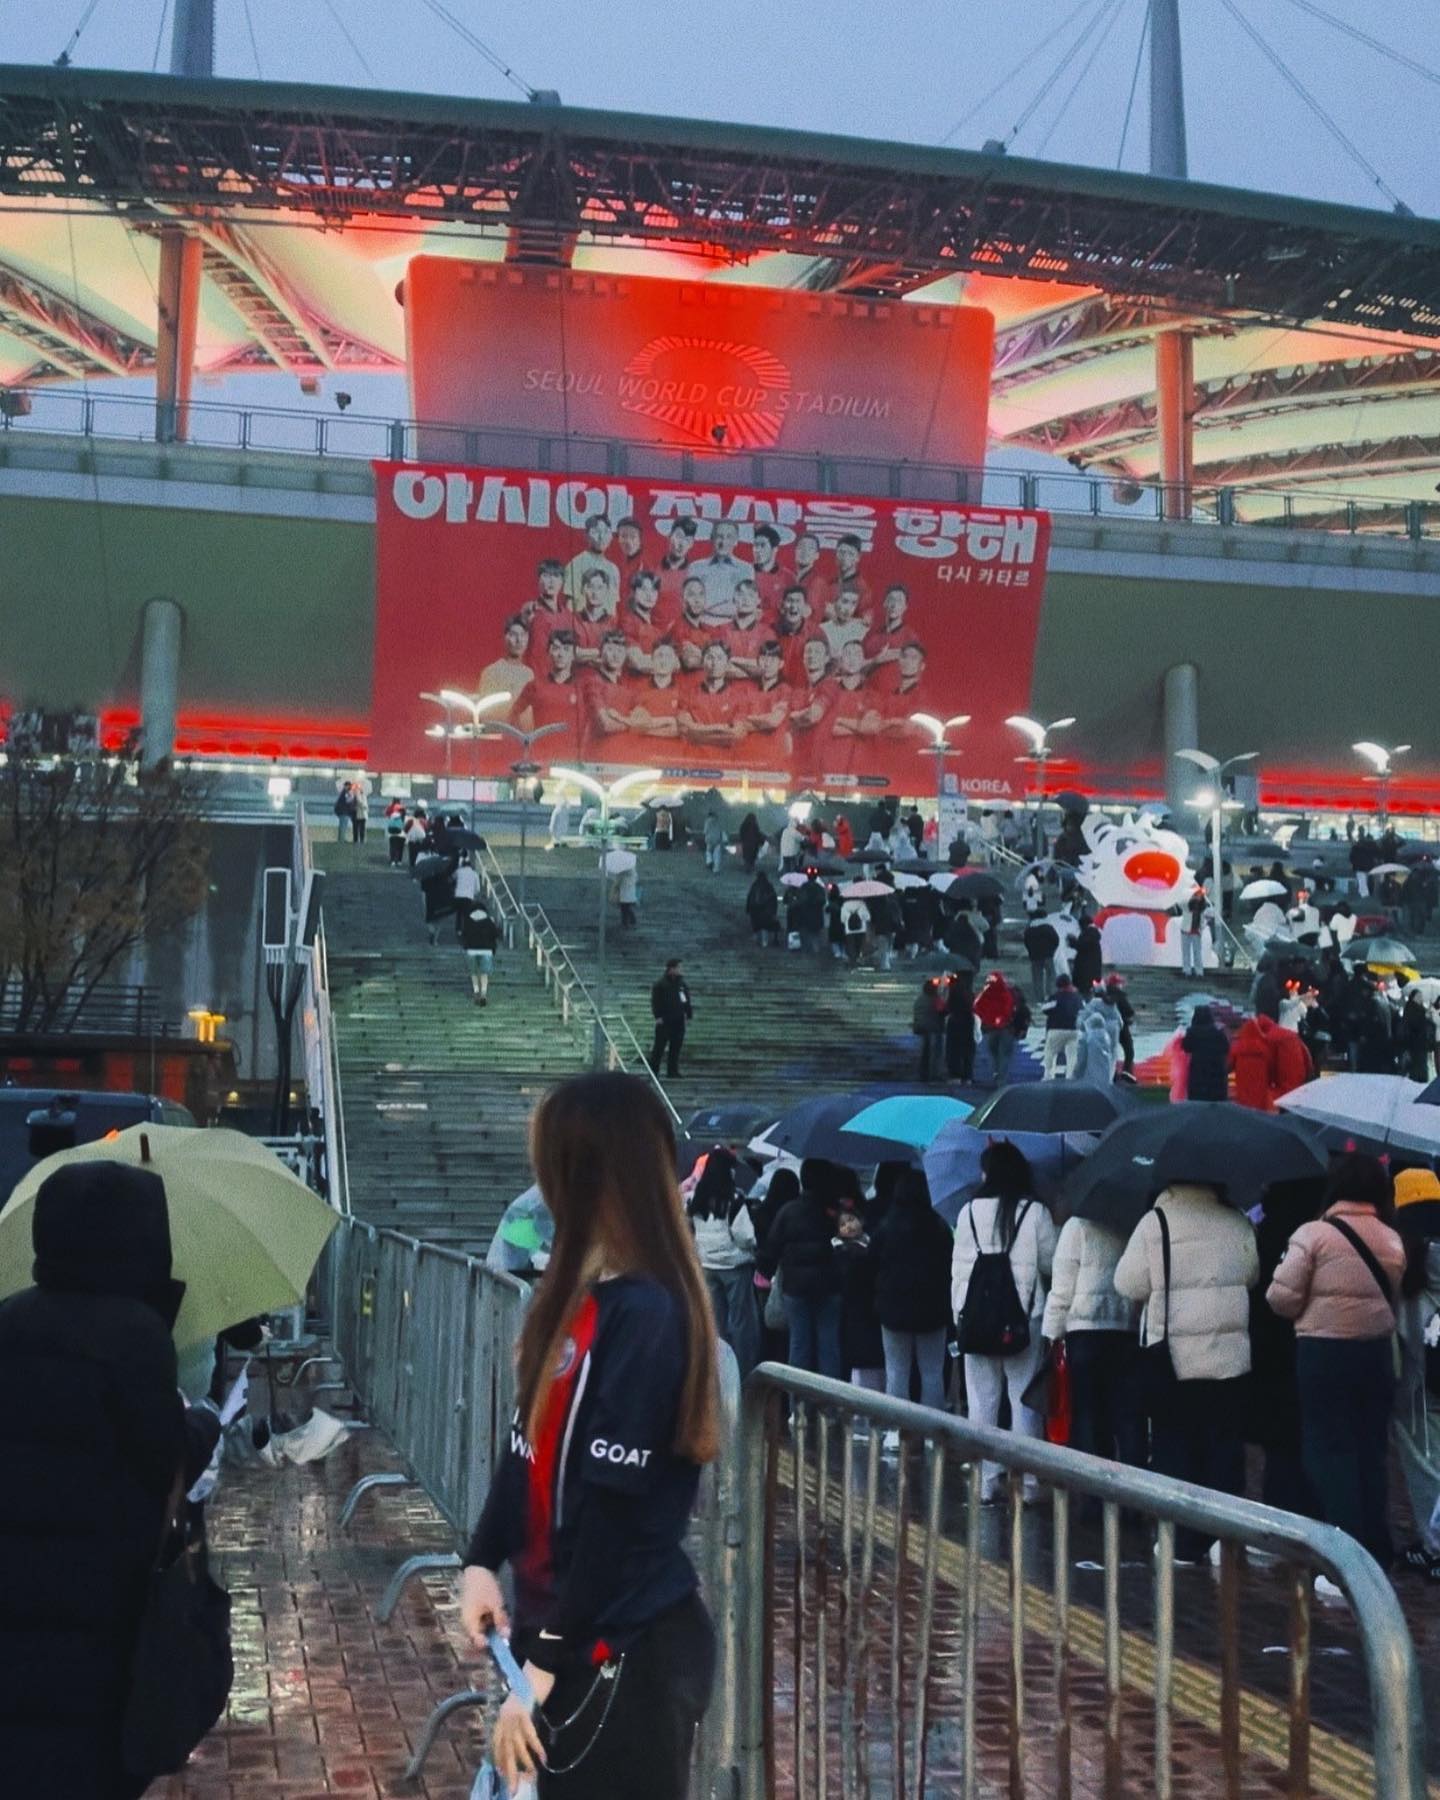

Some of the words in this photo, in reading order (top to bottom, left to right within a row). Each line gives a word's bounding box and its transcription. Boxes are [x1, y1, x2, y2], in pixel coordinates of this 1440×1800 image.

[523, 368, 604, 395] SEOUL
[619, 376, 707, 404] WORLD
[717, 386, 767, 408] CUP
[776, 392, 890, 418] STADIUM
[393, 470, 634, 532] 아시아
[649, 488, 876, 553] 정상을
[893, 507, 1038, 564] 향해
[937, 565, 972, 585] 다시
[979, 567, 1030, 587] 카타르
[961, 779, 1011, 794] KOREA
[590, 1438, 652, 1468] GOAT
